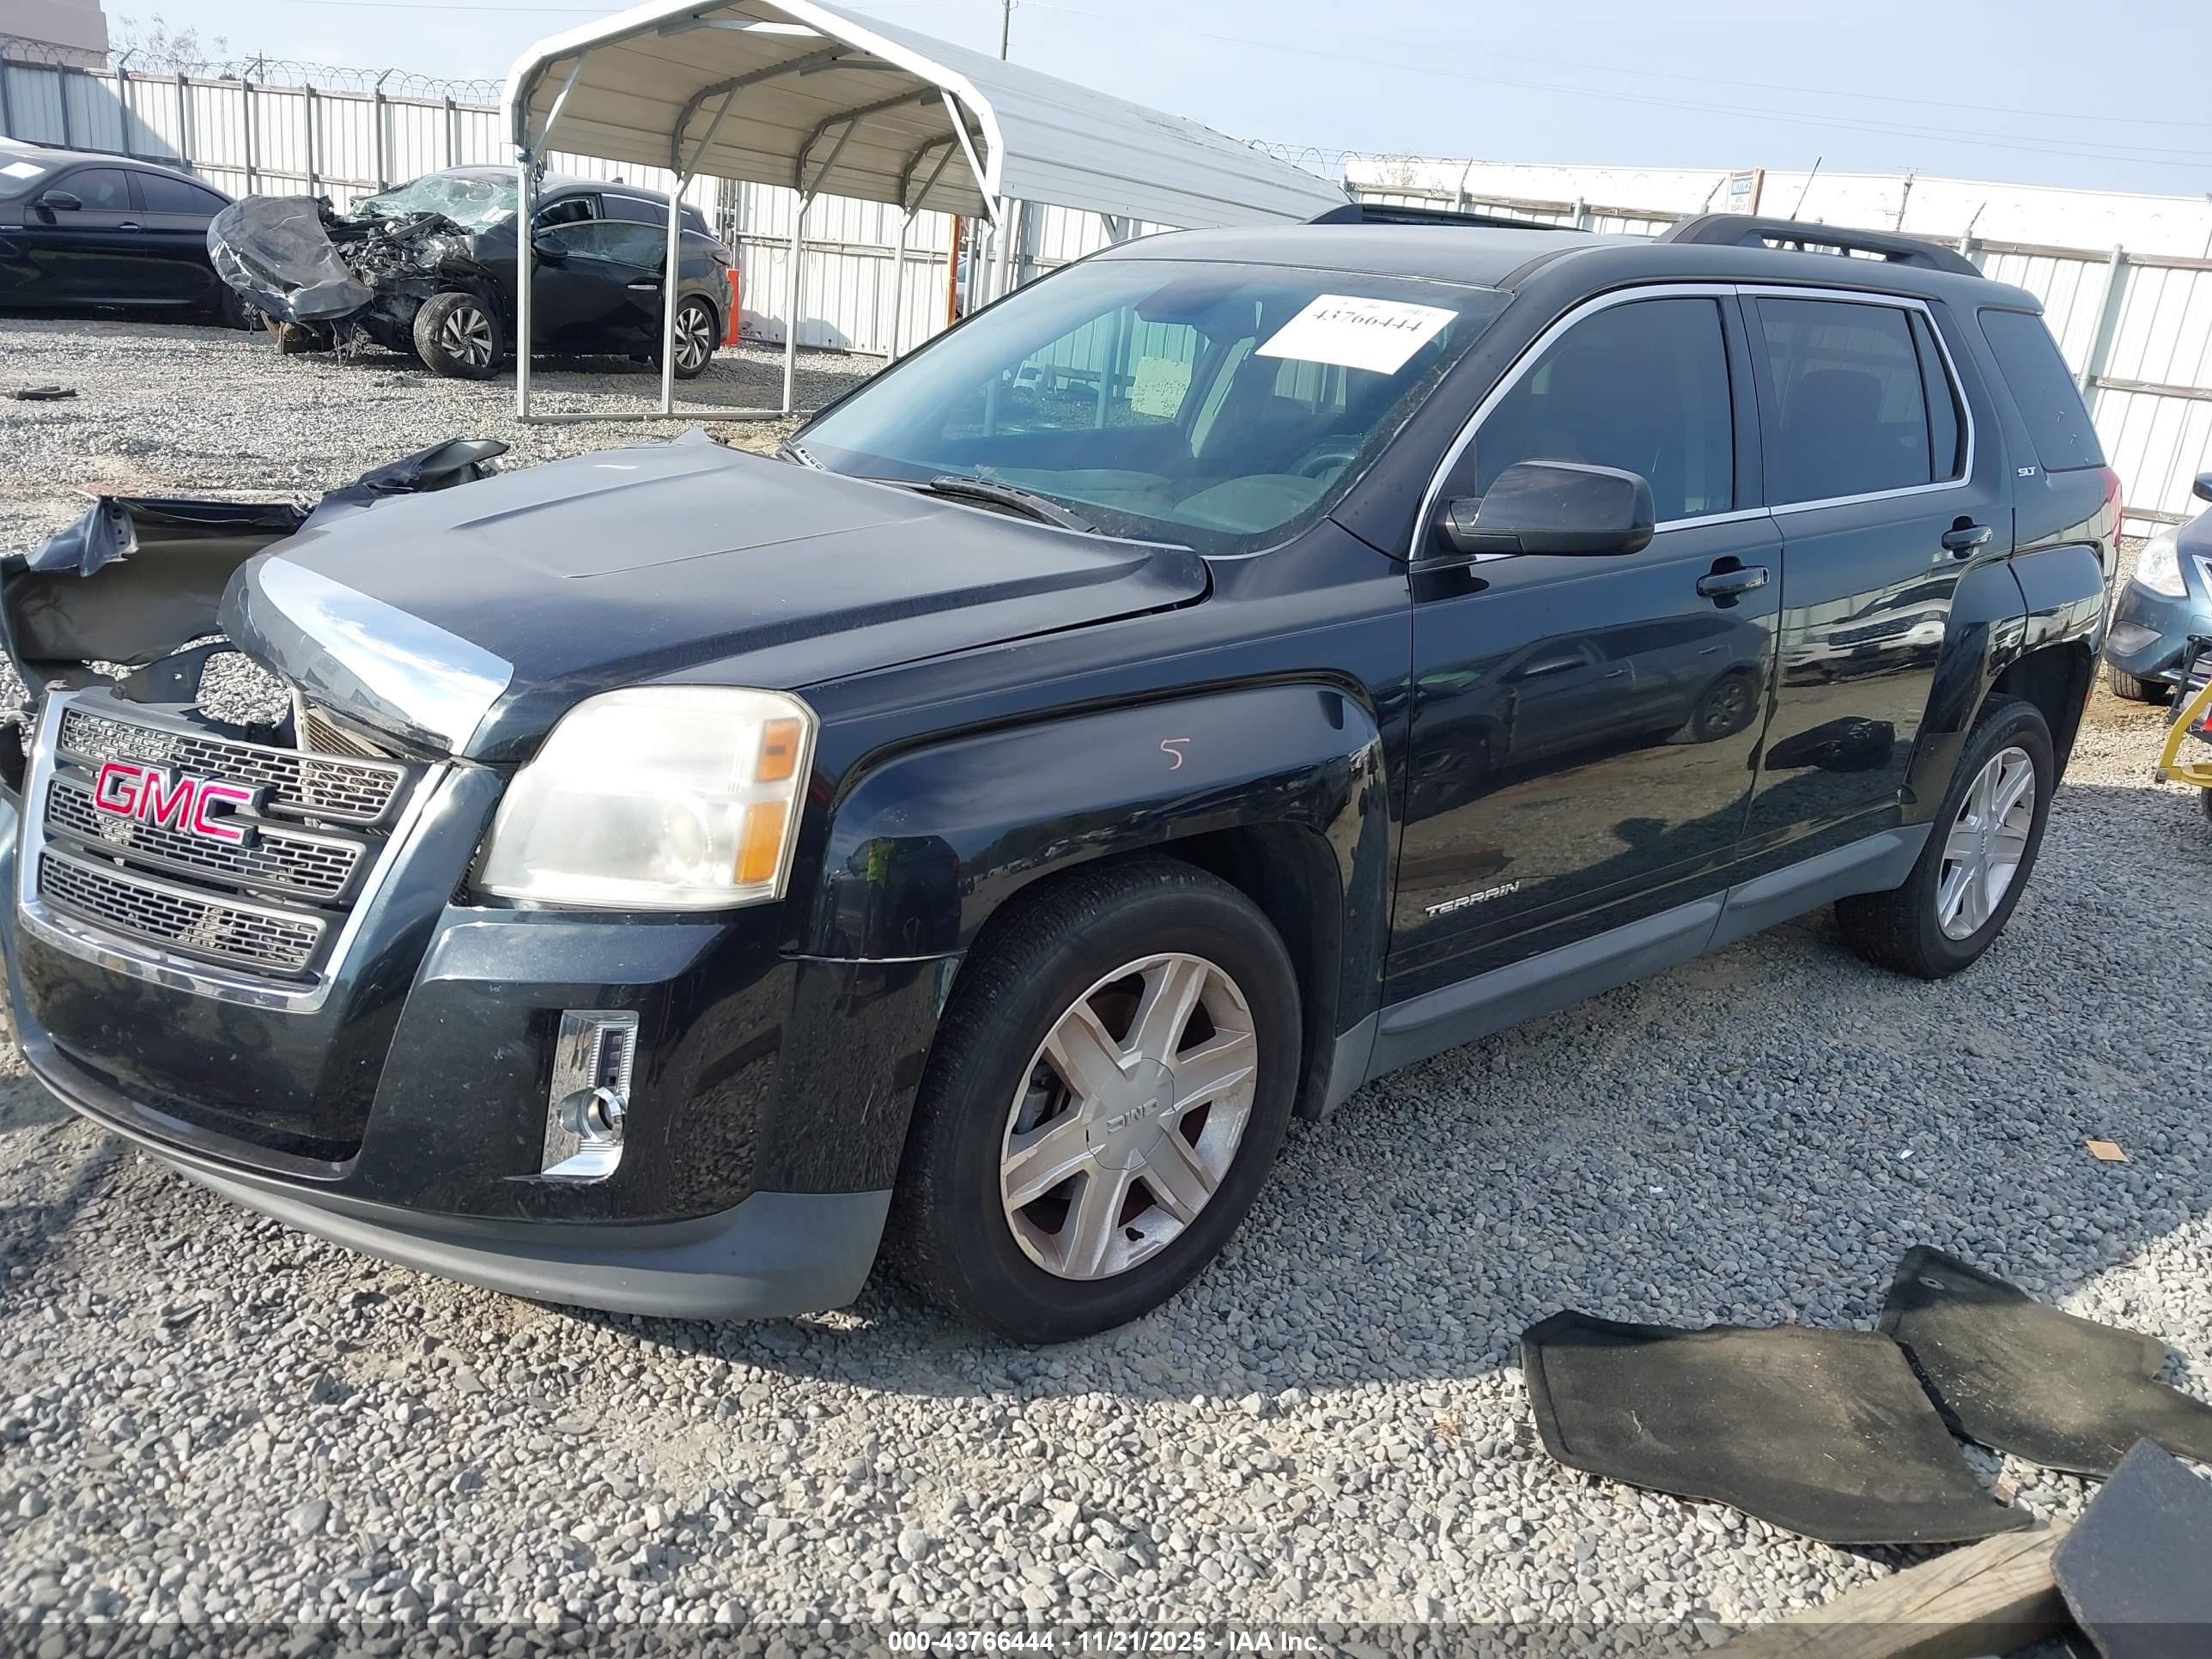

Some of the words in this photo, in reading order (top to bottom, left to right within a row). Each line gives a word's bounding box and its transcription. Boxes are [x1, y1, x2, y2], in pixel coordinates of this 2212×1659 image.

[1312, 309, 1423, 332] 43766444
[2018, 466, 2036, 477] SLT
[1160, 738, 1190, 770] 5
[94, 761, 261, 846] GMC
[1425, 880, 1520, 919] TERRAIN
